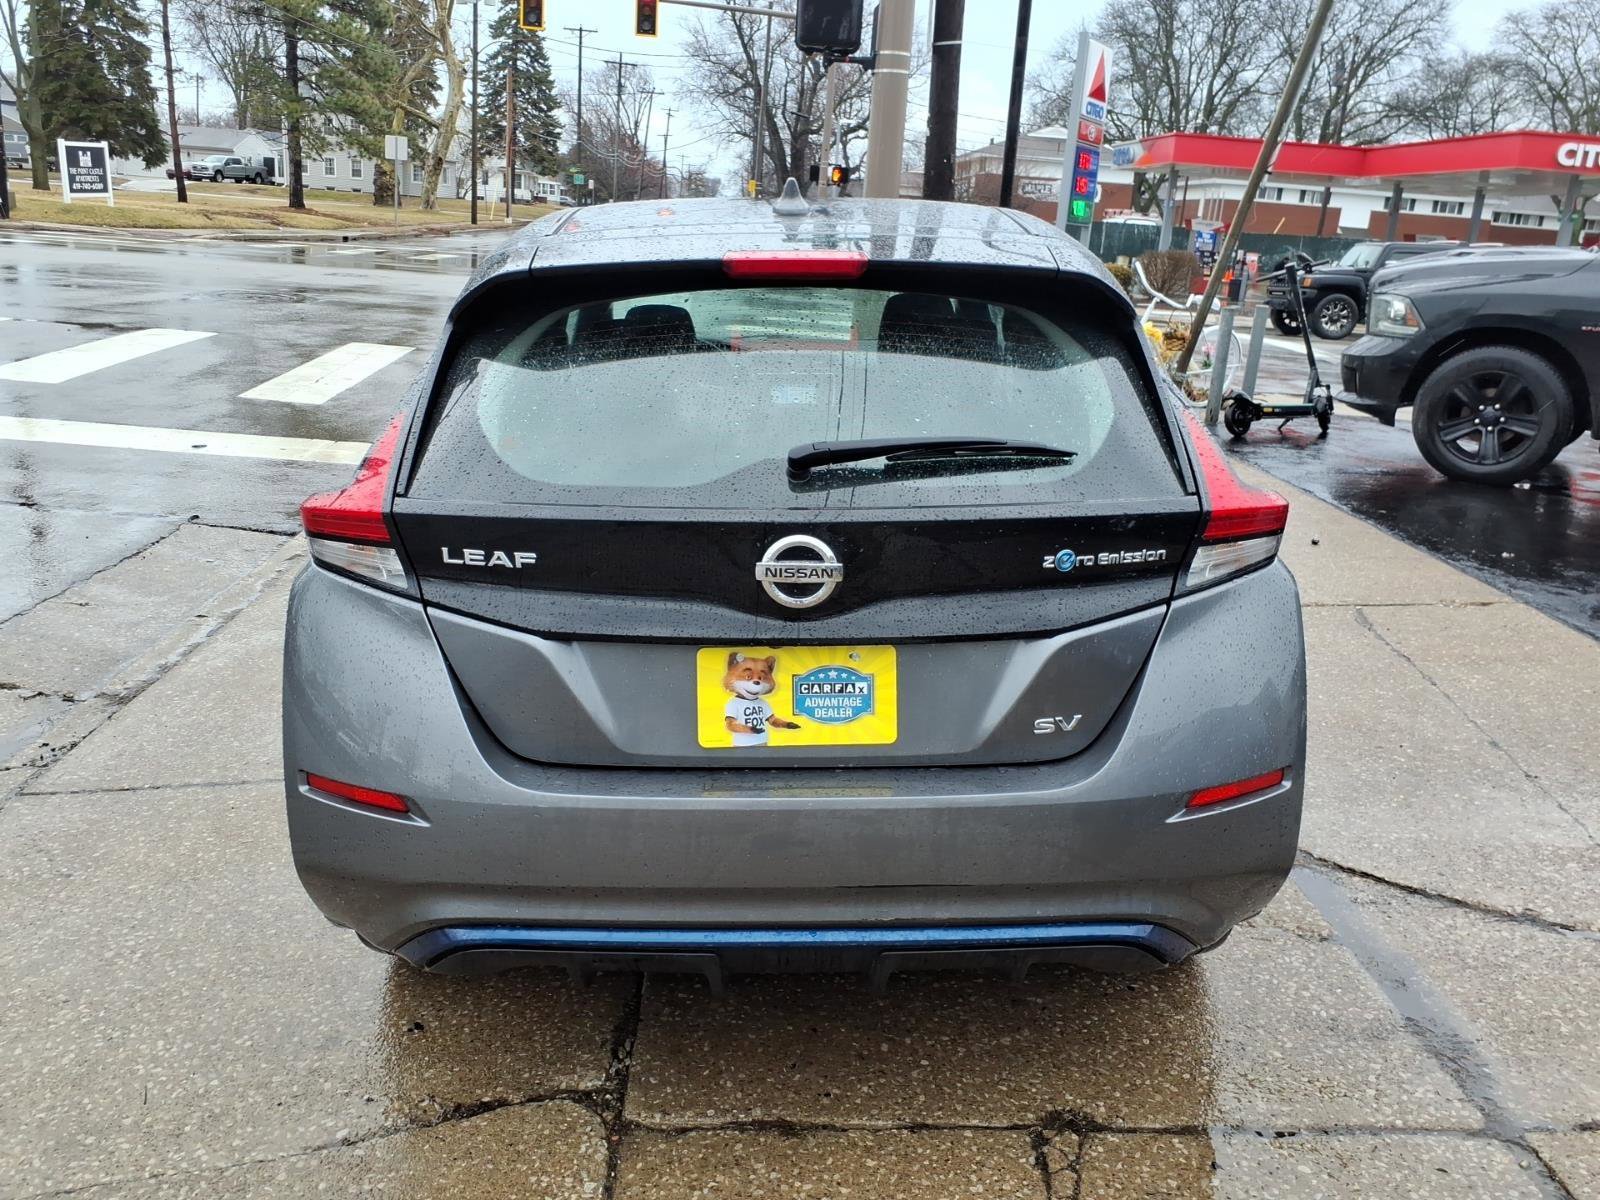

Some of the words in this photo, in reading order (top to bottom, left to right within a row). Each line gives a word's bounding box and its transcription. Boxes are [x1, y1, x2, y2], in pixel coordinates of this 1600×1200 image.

[1557, 142, 1600, 168] CIT
[441, 547, 537, 569] LEAF
[1098, 549, 1166, 565] Emission
[765, 567, 833, 579] NISSAN
[800, 682, 868, 695] CARFAX
[804, 696, 862, 707] ADVANTAGE
[743, 706, 764, 717] CAR
[814, 707, 853, 718] DEALER
[744, 717, 765, 728] FOX
[1033, 714, 1082, 735] SV
